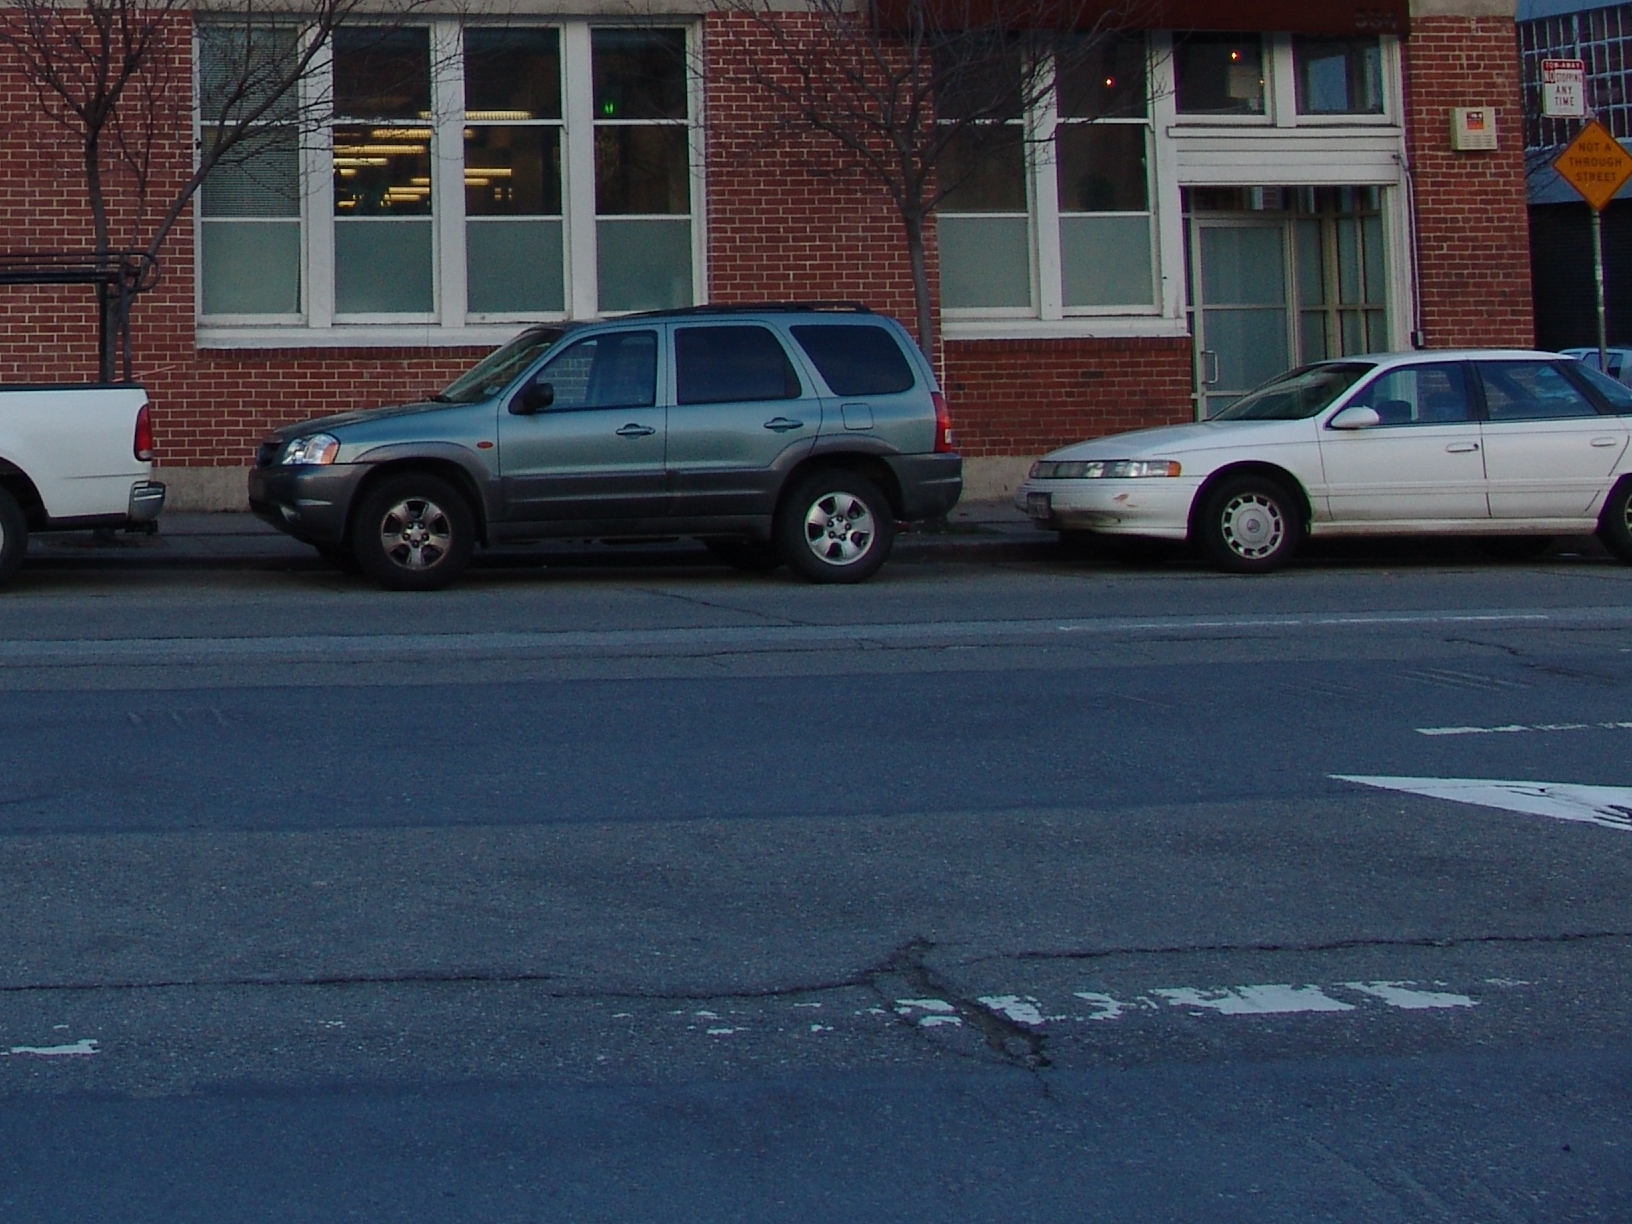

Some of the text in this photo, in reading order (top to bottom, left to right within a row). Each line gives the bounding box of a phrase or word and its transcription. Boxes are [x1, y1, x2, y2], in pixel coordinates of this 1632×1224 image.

[1556, 86, 1572, 95] ANY
[1555, 96, 1575, 106] TIME
[1578, 142, 1612, 152] NOT A
[1568, 156, 1622, 168] THROUGH
[1576, 171, 1616, 182] STREET
